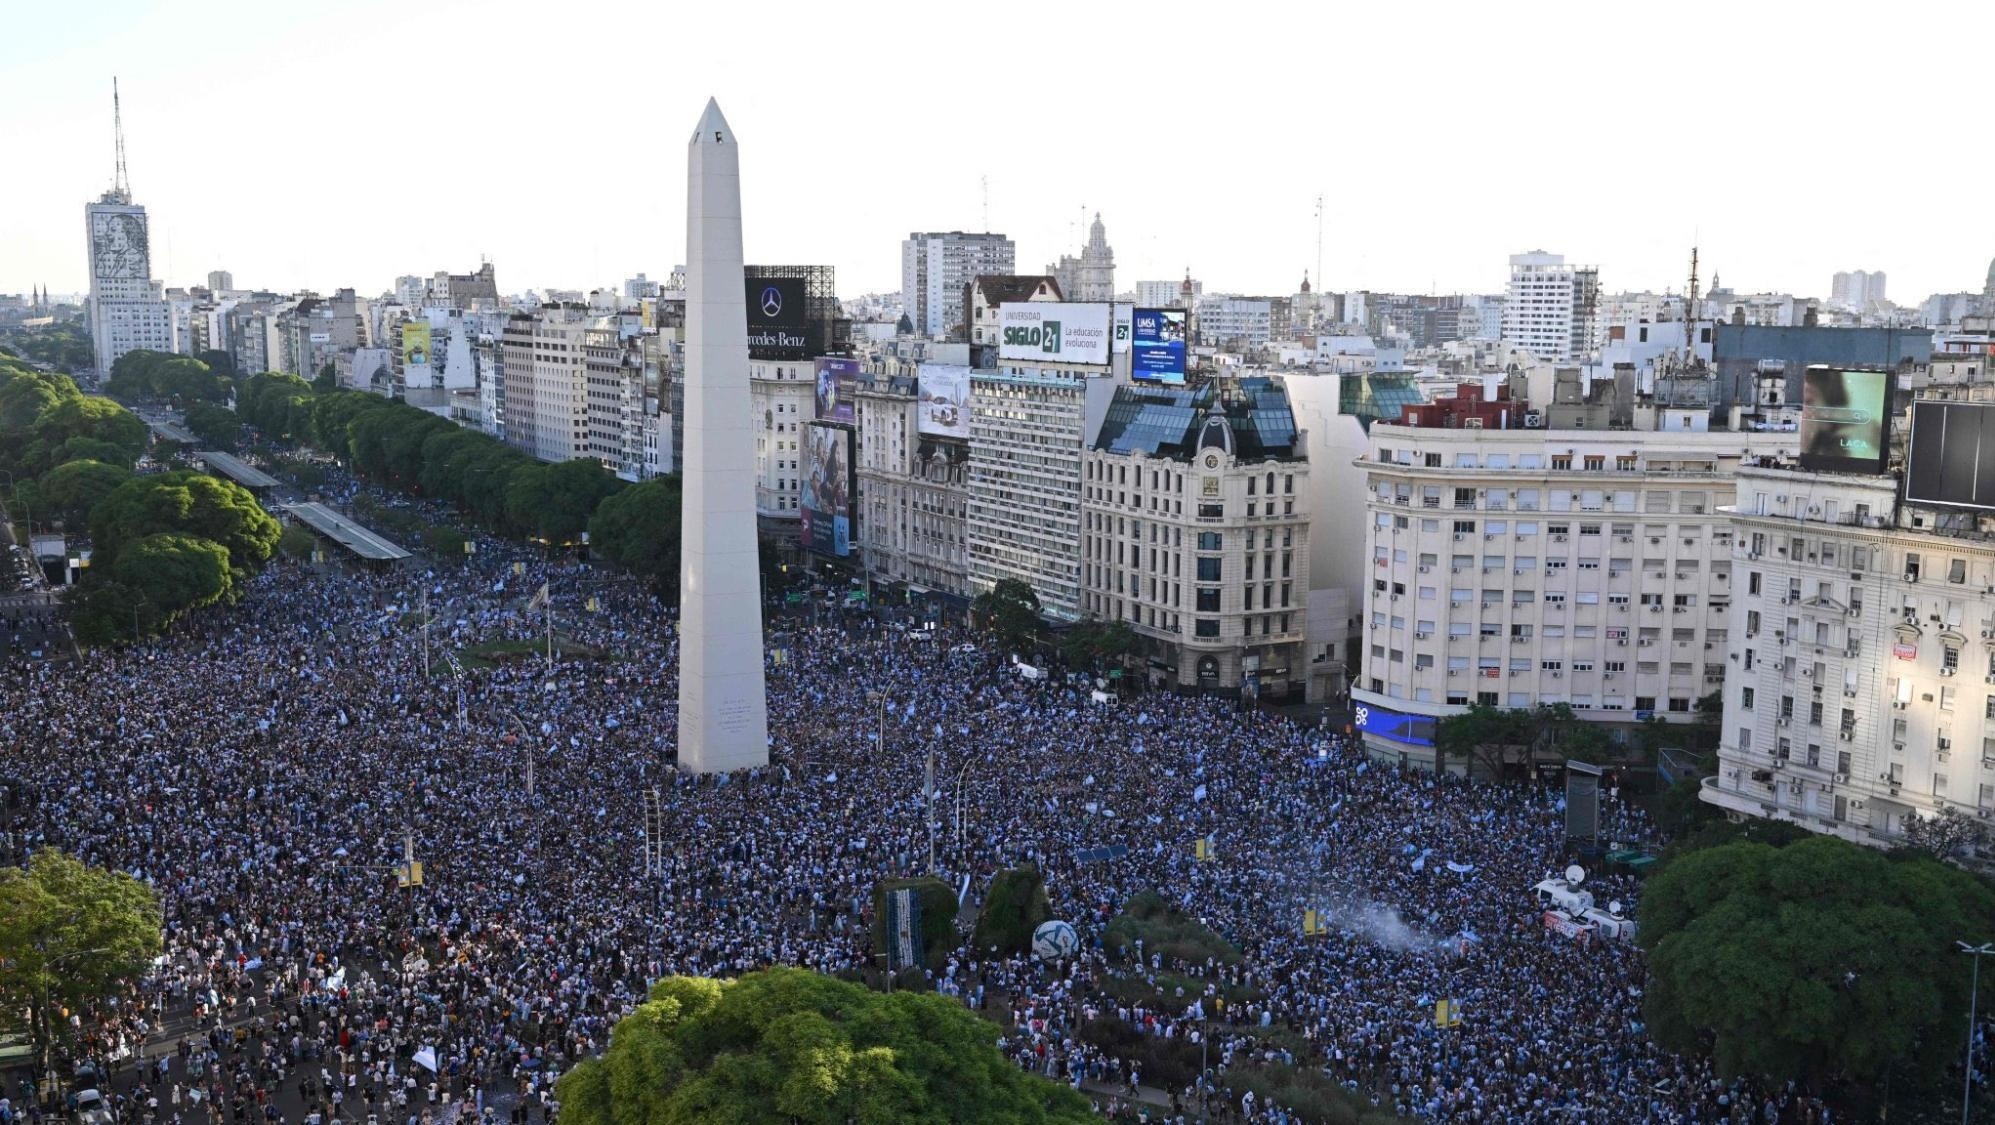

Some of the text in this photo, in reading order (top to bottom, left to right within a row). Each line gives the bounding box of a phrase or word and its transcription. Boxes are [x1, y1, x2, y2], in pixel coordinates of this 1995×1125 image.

[1005, 311, 1041, 321] UNIVERSIDAD
[1065, 327, 1104, 338] La educación
[1118, 328, 1128, 340] 21
[748, 331, 805, 346] rcedes-Benz
[1003, 326, 1057, 352] SIGLO 21
[1065, 339, 1097, 349] evoluciona
